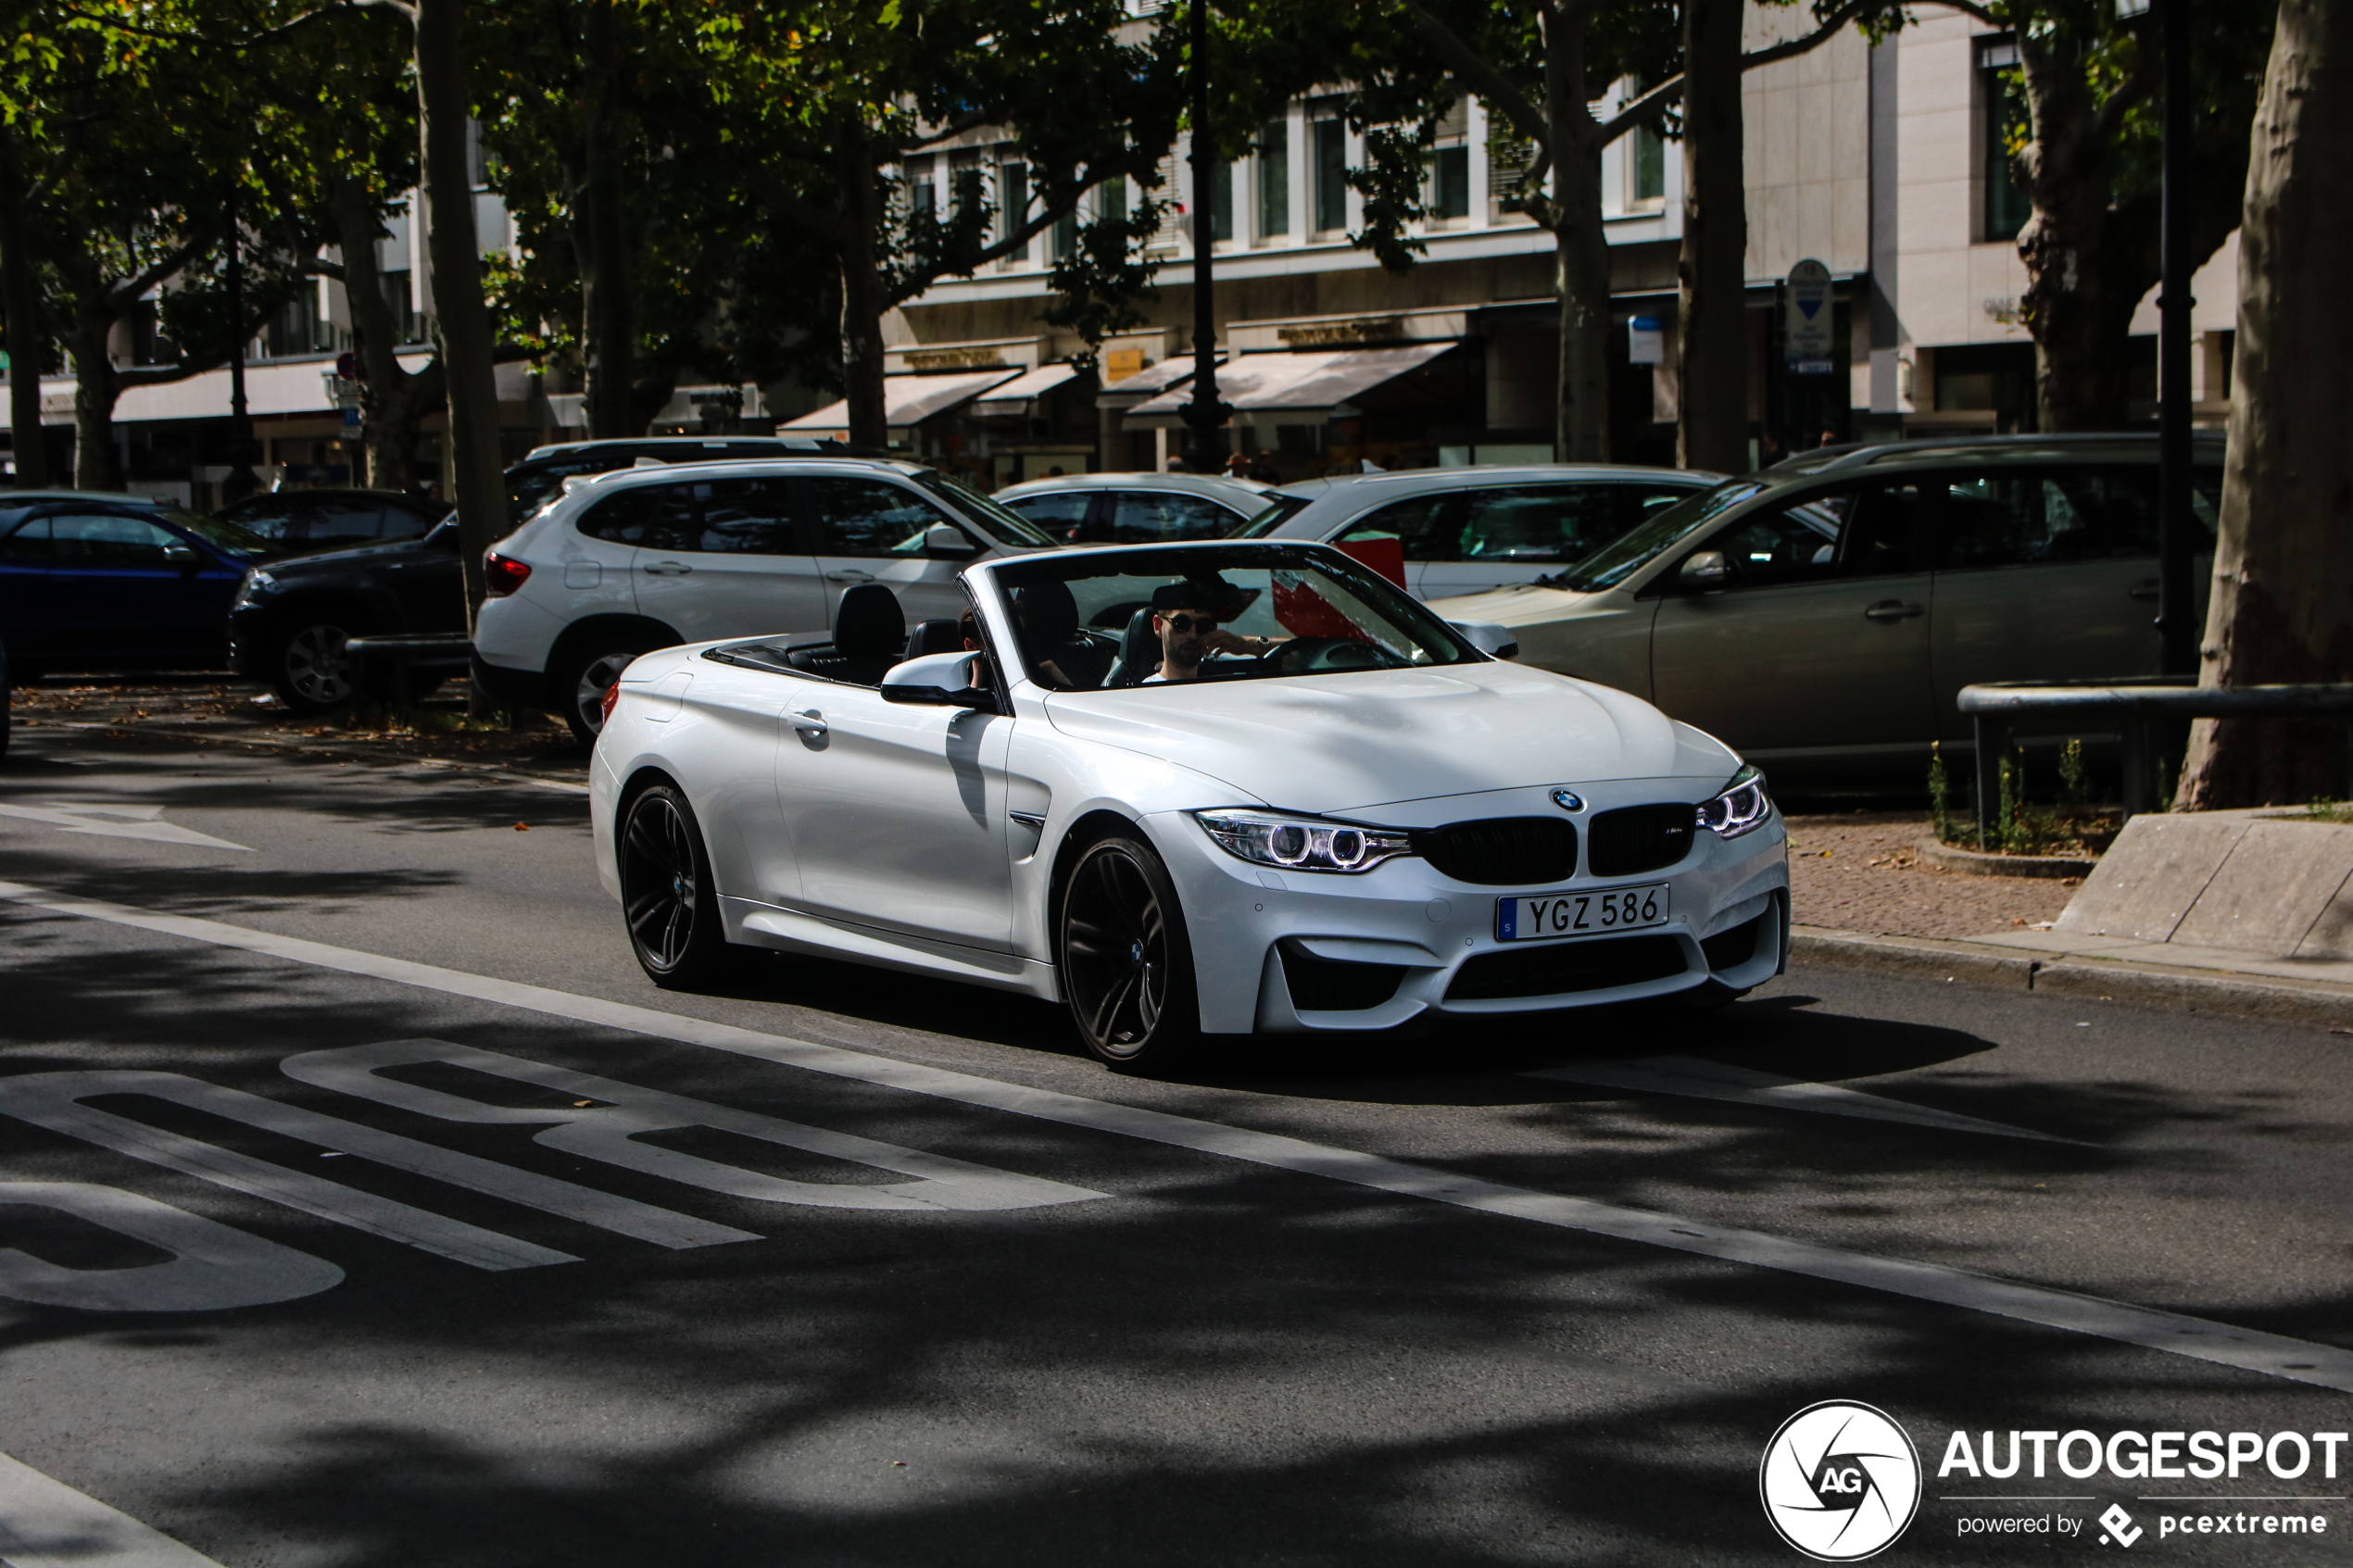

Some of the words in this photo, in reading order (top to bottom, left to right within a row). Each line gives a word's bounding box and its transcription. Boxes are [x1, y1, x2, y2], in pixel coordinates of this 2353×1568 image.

[1504, 923, 1511, 932] S
[1529, 897, 1591, 934] YGZ
[1601, 889, 1657, 926] 586
